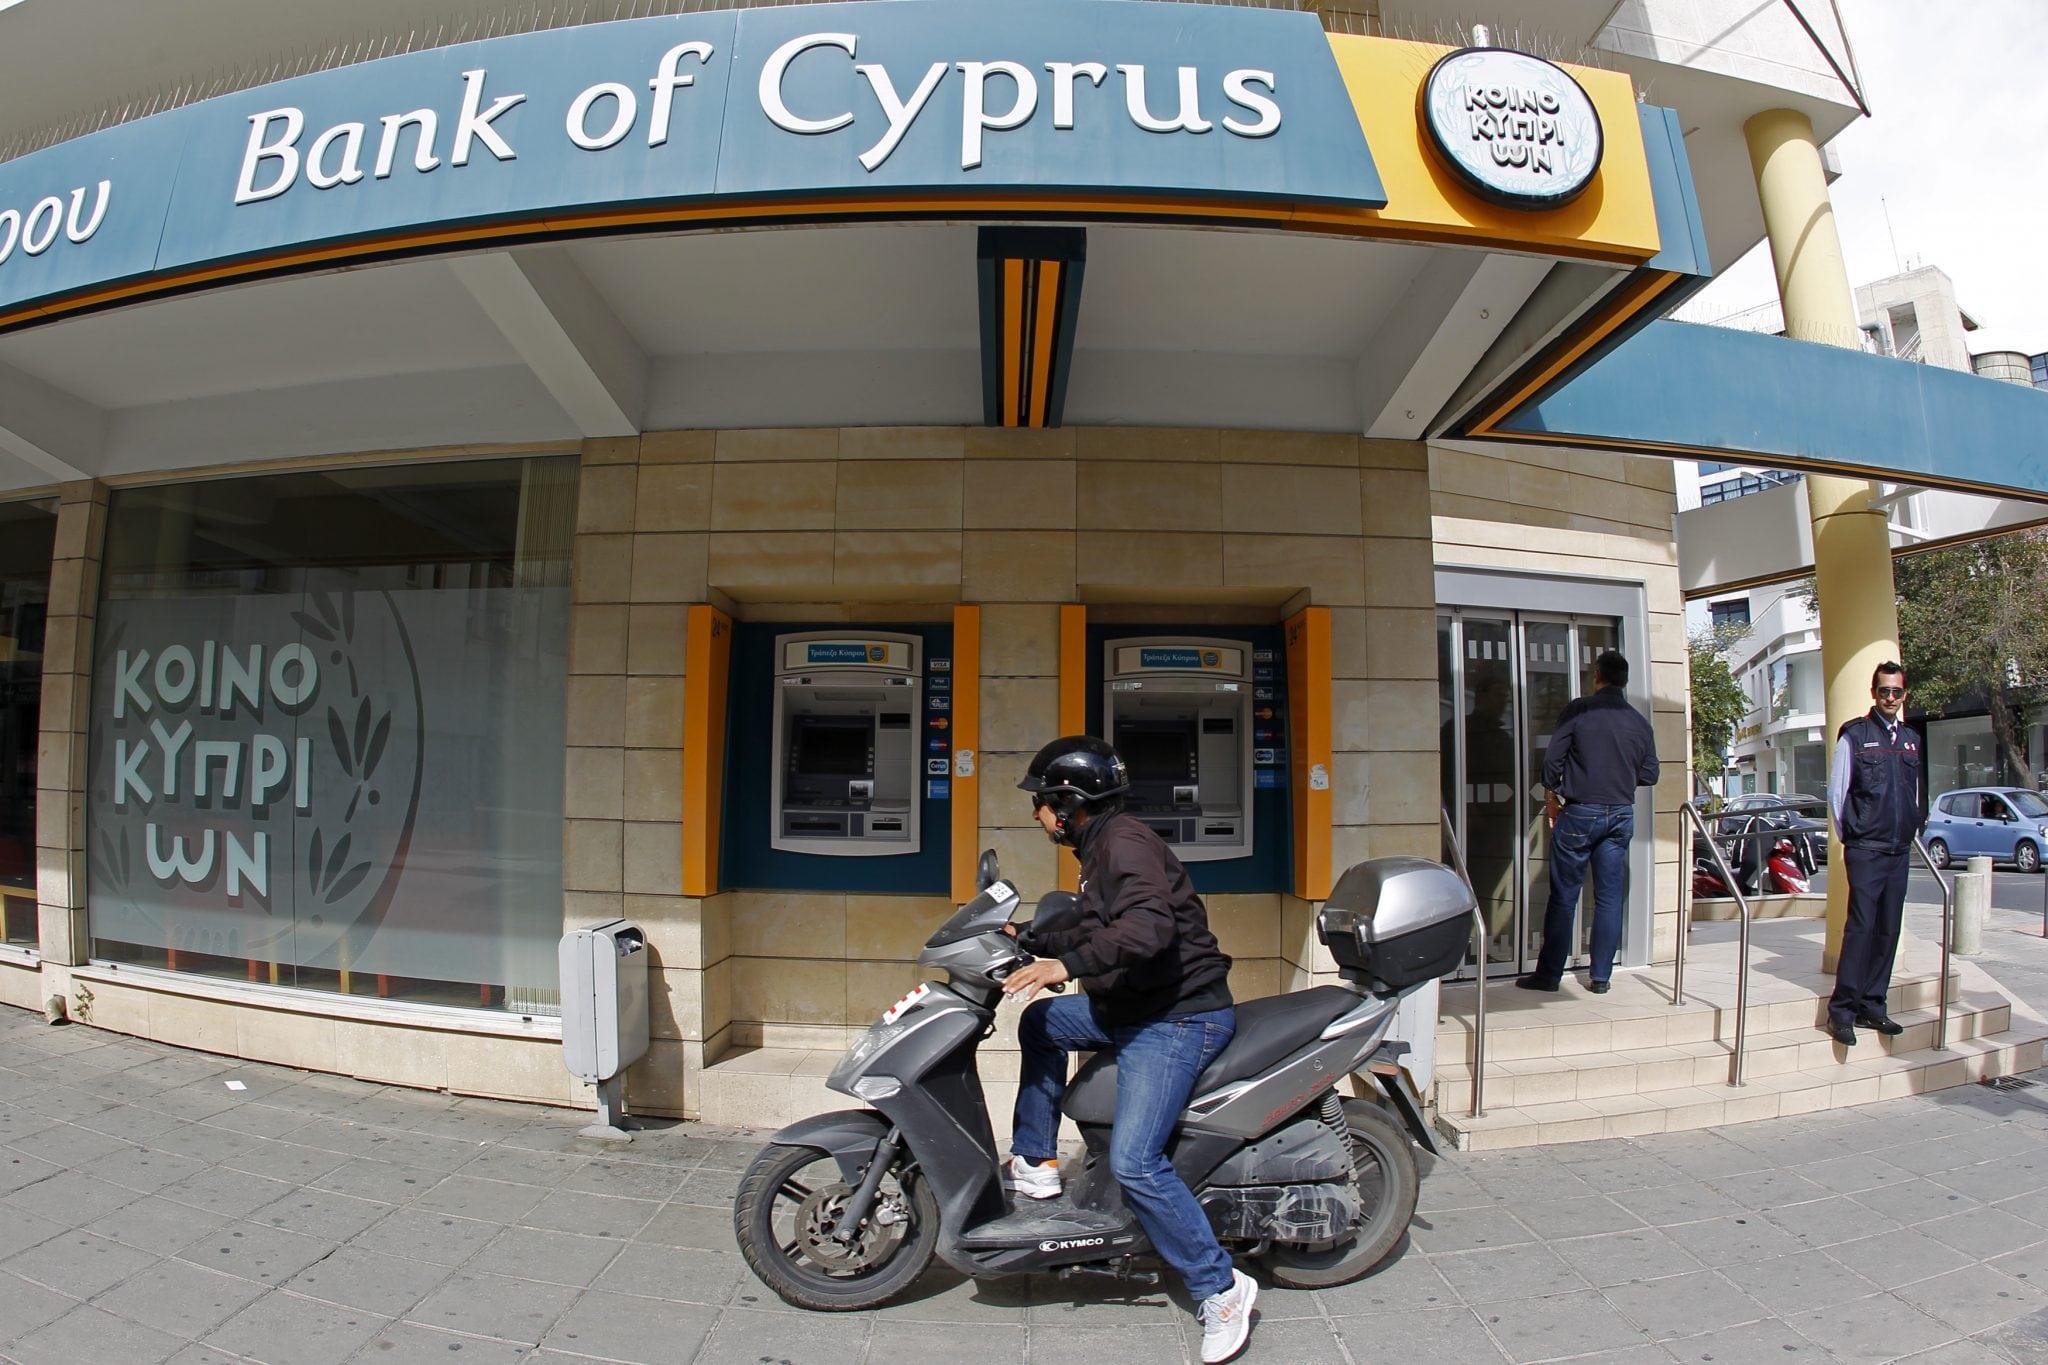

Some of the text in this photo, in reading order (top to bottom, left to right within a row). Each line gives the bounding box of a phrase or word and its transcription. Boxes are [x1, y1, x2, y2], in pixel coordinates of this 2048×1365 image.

[234, 31, 1283, 206] Bank of Cyprus
[113, 639, 319, 720] ΚΟΙΝΟ
[1060, 1237, 1105, 1250] KYMCO
